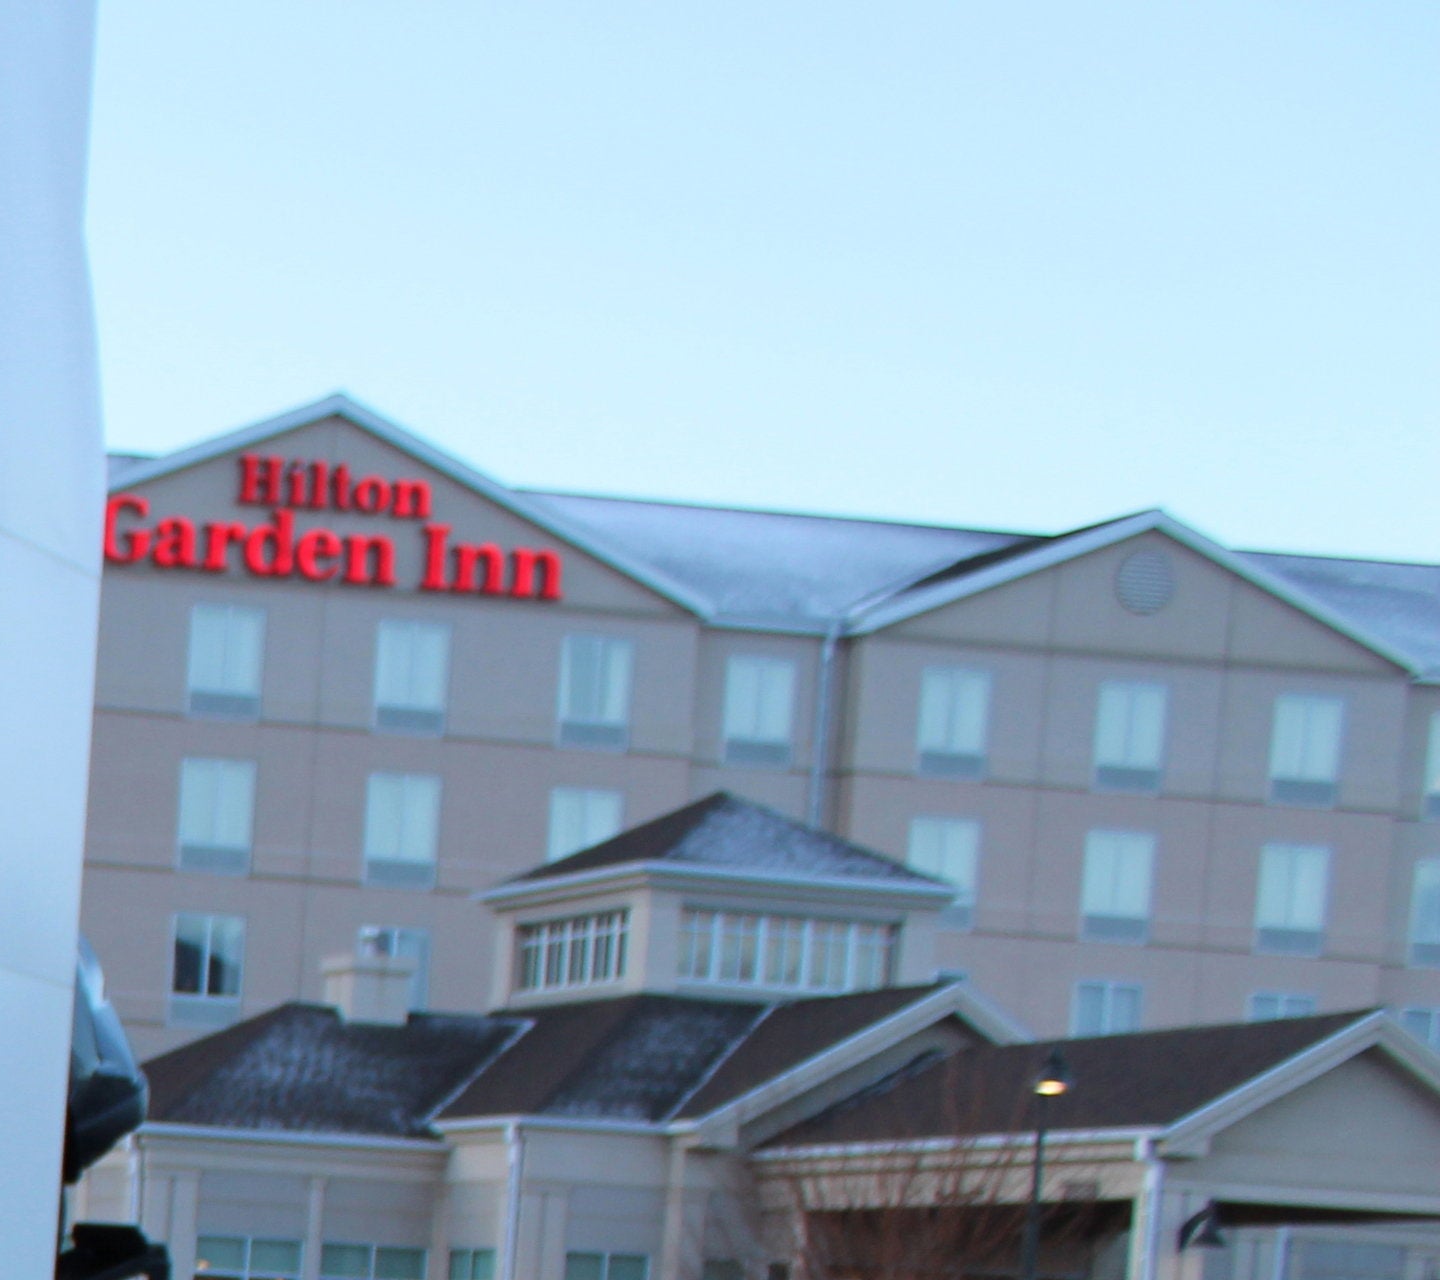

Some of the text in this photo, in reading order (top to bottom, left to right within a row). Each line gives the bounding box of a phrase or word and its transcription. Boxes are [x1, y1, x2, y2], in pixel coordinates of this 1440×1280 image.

[239, 453, 433, 519] Hilton
[104, 494, 563, 600] Garden Inn
